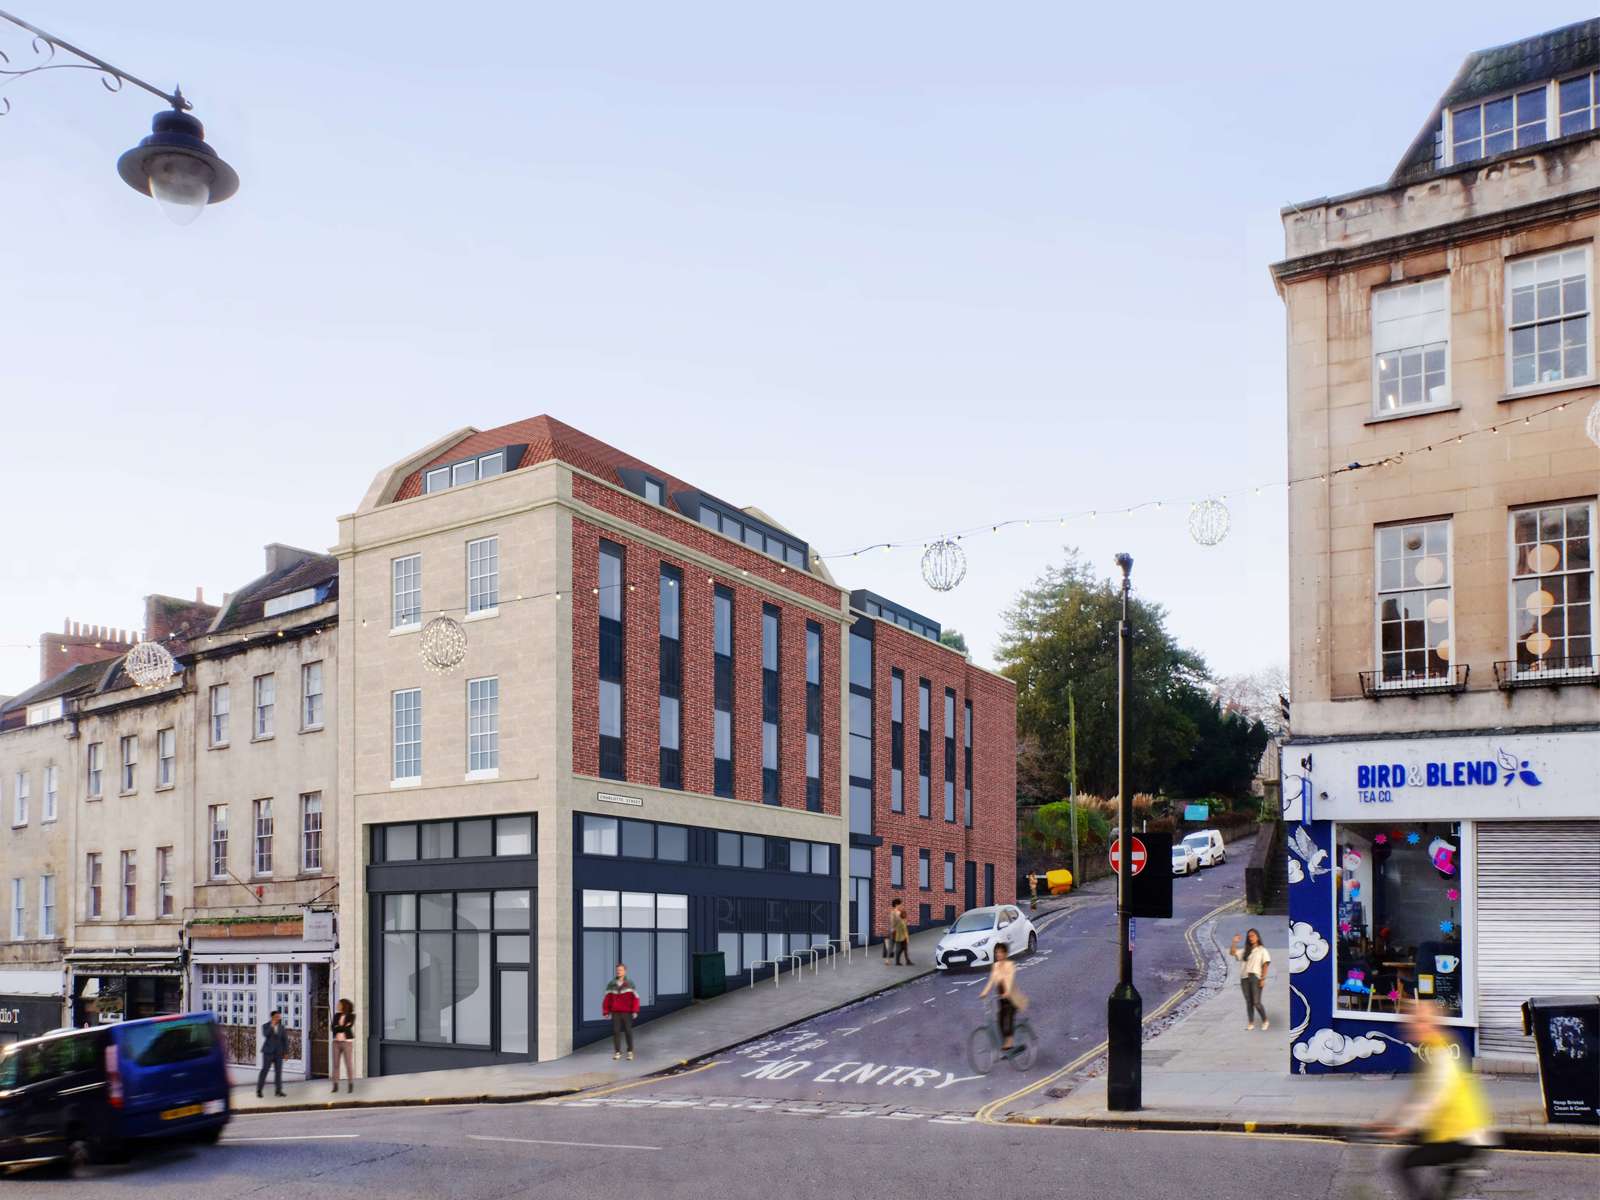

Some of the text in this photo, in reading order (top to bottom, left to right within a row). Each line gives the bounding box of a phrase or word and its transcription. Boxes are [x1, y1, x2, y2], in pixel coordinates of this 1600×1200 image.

[1358, 764, 1405, 789] BIRD
[1426, 761, 1498, 787] BLEND
[1358, 790, 1376, 803] TEA
[741, 1054, 987, 1088] NO ENTRY
